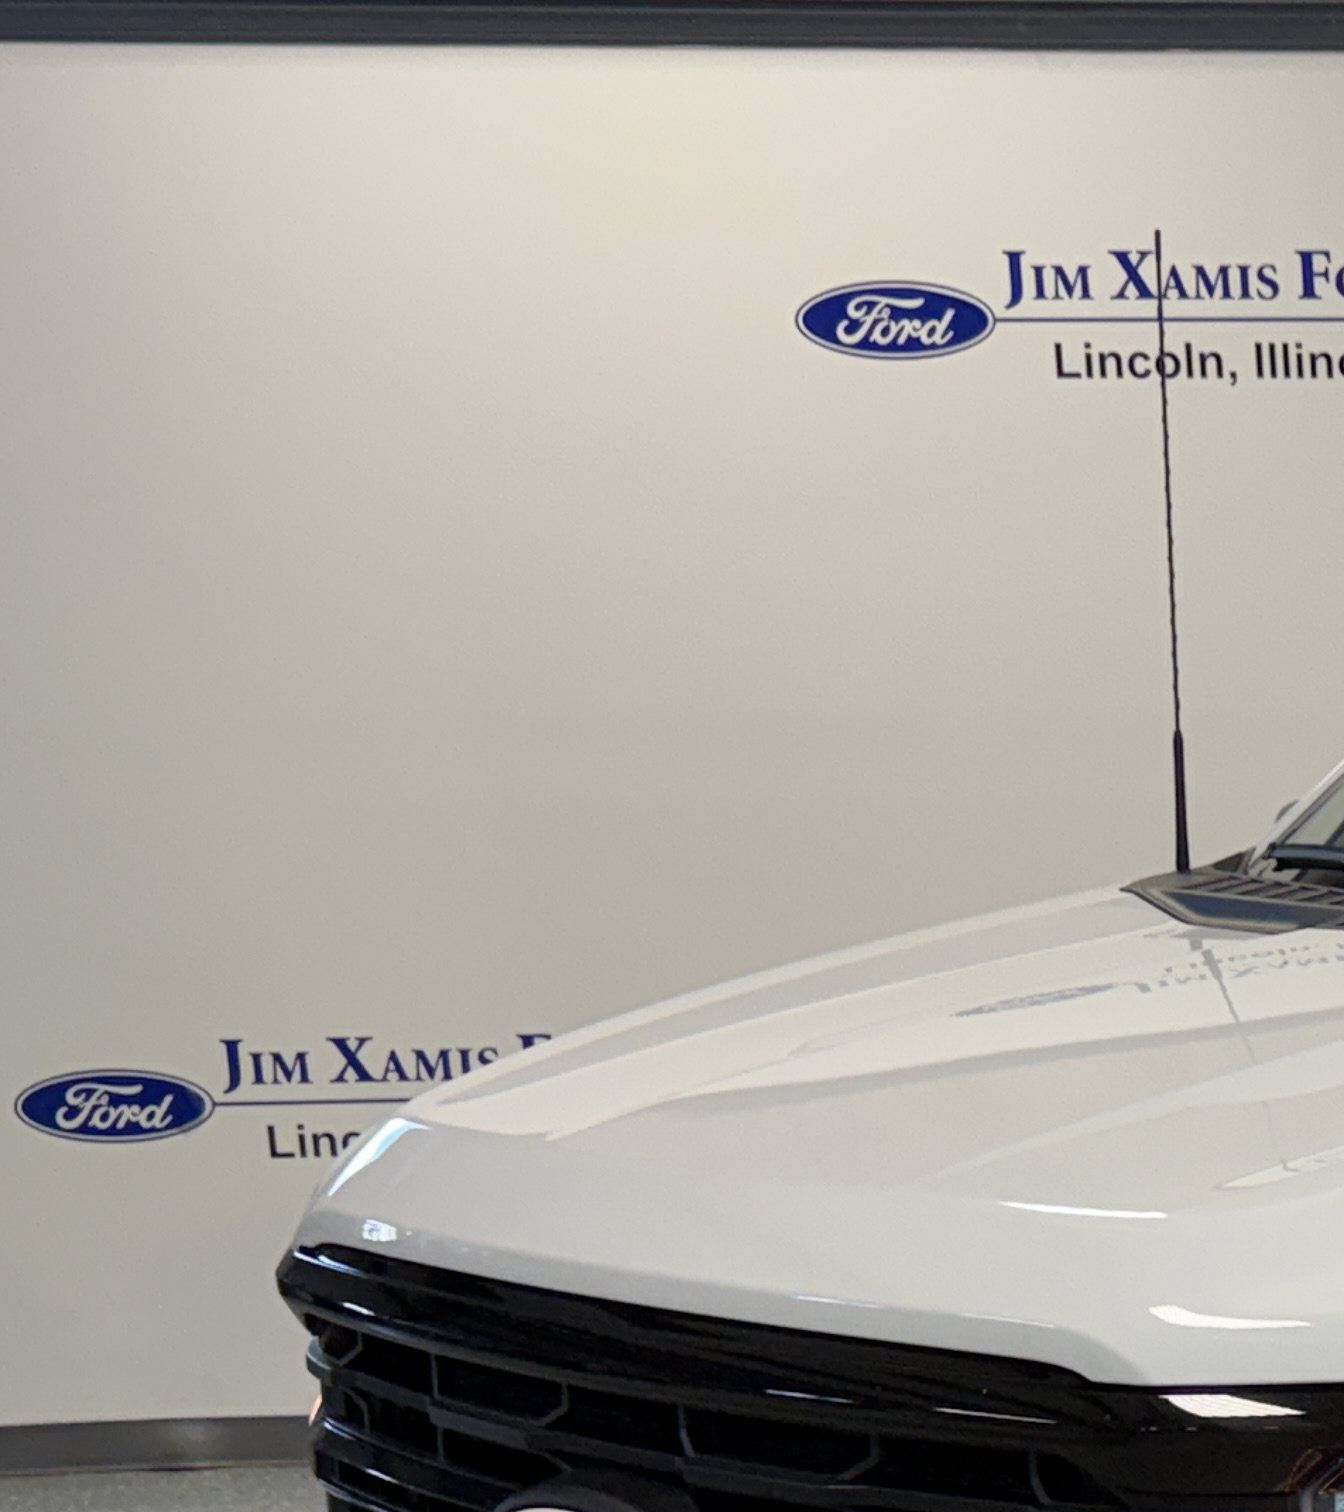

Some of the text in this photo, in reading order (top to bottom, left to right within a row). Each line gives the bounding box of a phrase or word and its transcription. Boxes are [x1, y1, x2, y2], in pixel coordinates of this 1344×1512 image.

[1002, 249, 1094, 311] JIM
[1107, 249, 1281, 301] XAMIS
[1053, 341, 1239, 387] Lincoln,
[219, 1038, 314, 1094] JIM
